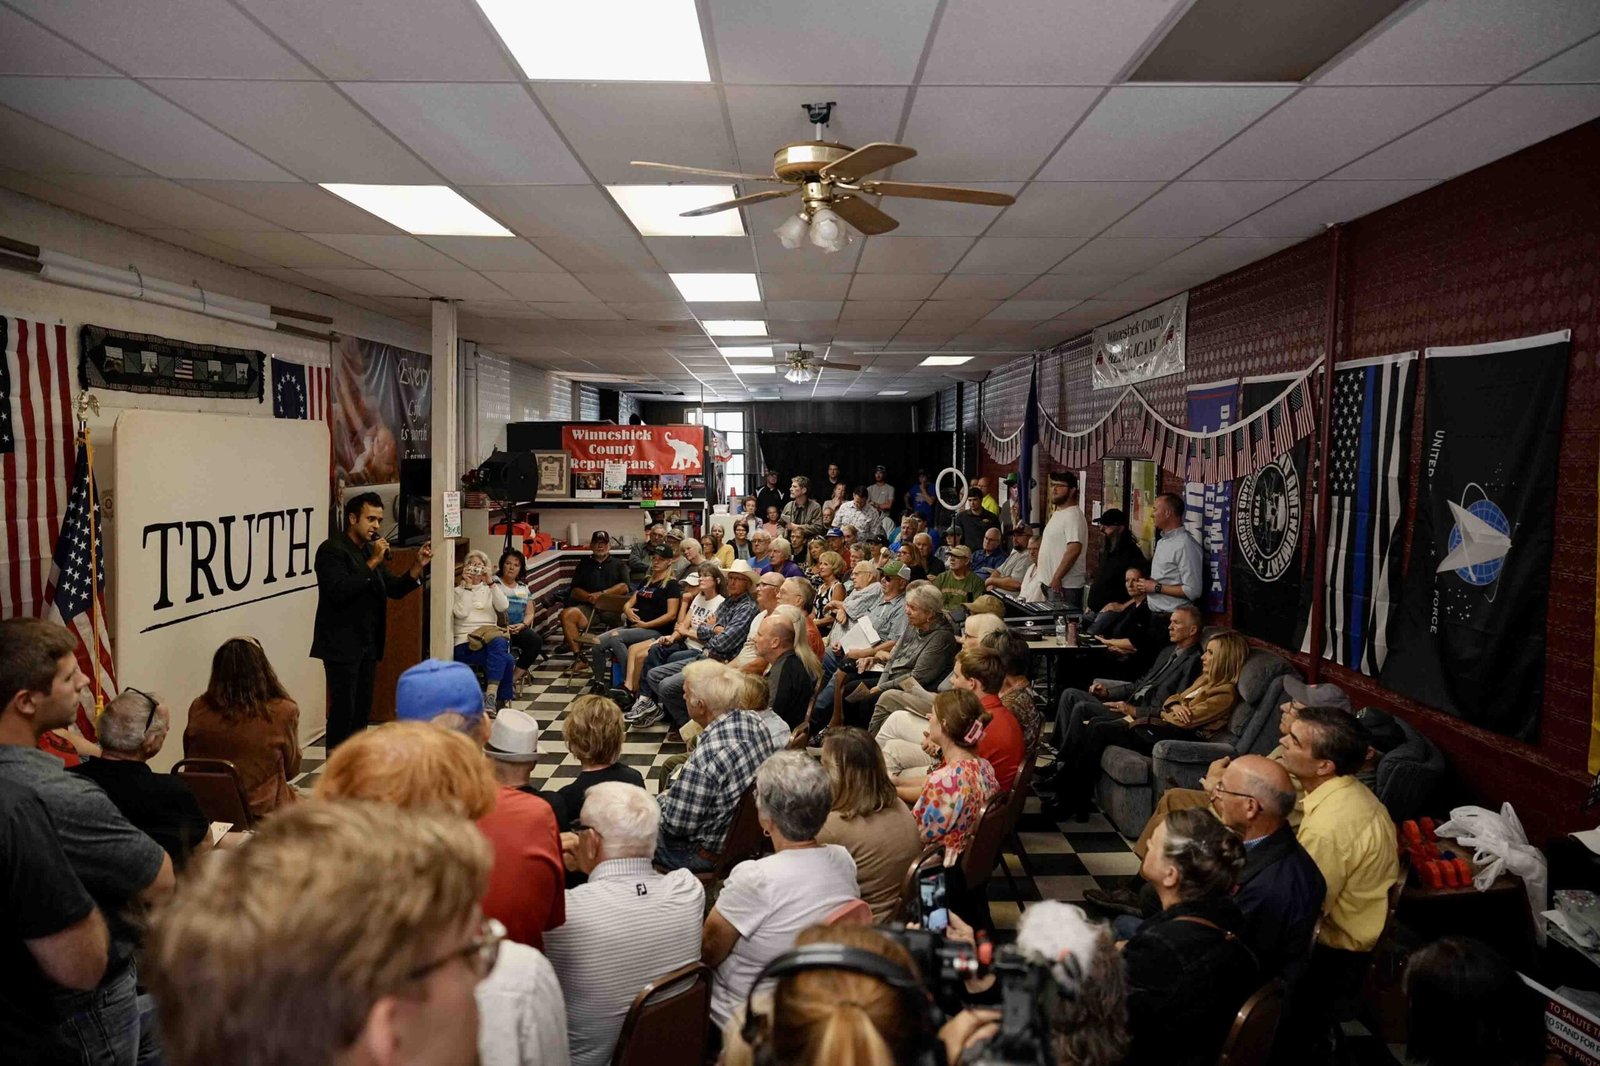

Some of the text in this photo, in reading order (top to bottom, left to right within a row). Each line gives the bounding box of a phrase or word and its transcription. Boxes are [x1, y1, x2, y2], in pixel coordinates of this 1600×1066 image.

[398, 358, 431, 390] Every
[408, 400, 422, 422] Life
[400, 423, 428, 441] is worth
[571, 429, 652, 441] Winneshiek
[588, 444, 636, 456] County
[1428, 430, 1446, 478] UNITED
[1252, 494, 1262, 527] 1789
[1264, 473, 1299, 578] AMENDMENT
[142, 507, 314, 611] TRUTH
[1429, 588, 1440, 635] FORCE
[1549, 1001, 1561, 1015] TO
[1562, 1009, 1592, 1033] SALUTE
[1555, 1021, 1580, 1041] STAND
[1580, 1036, 1596, 1051] FOR
